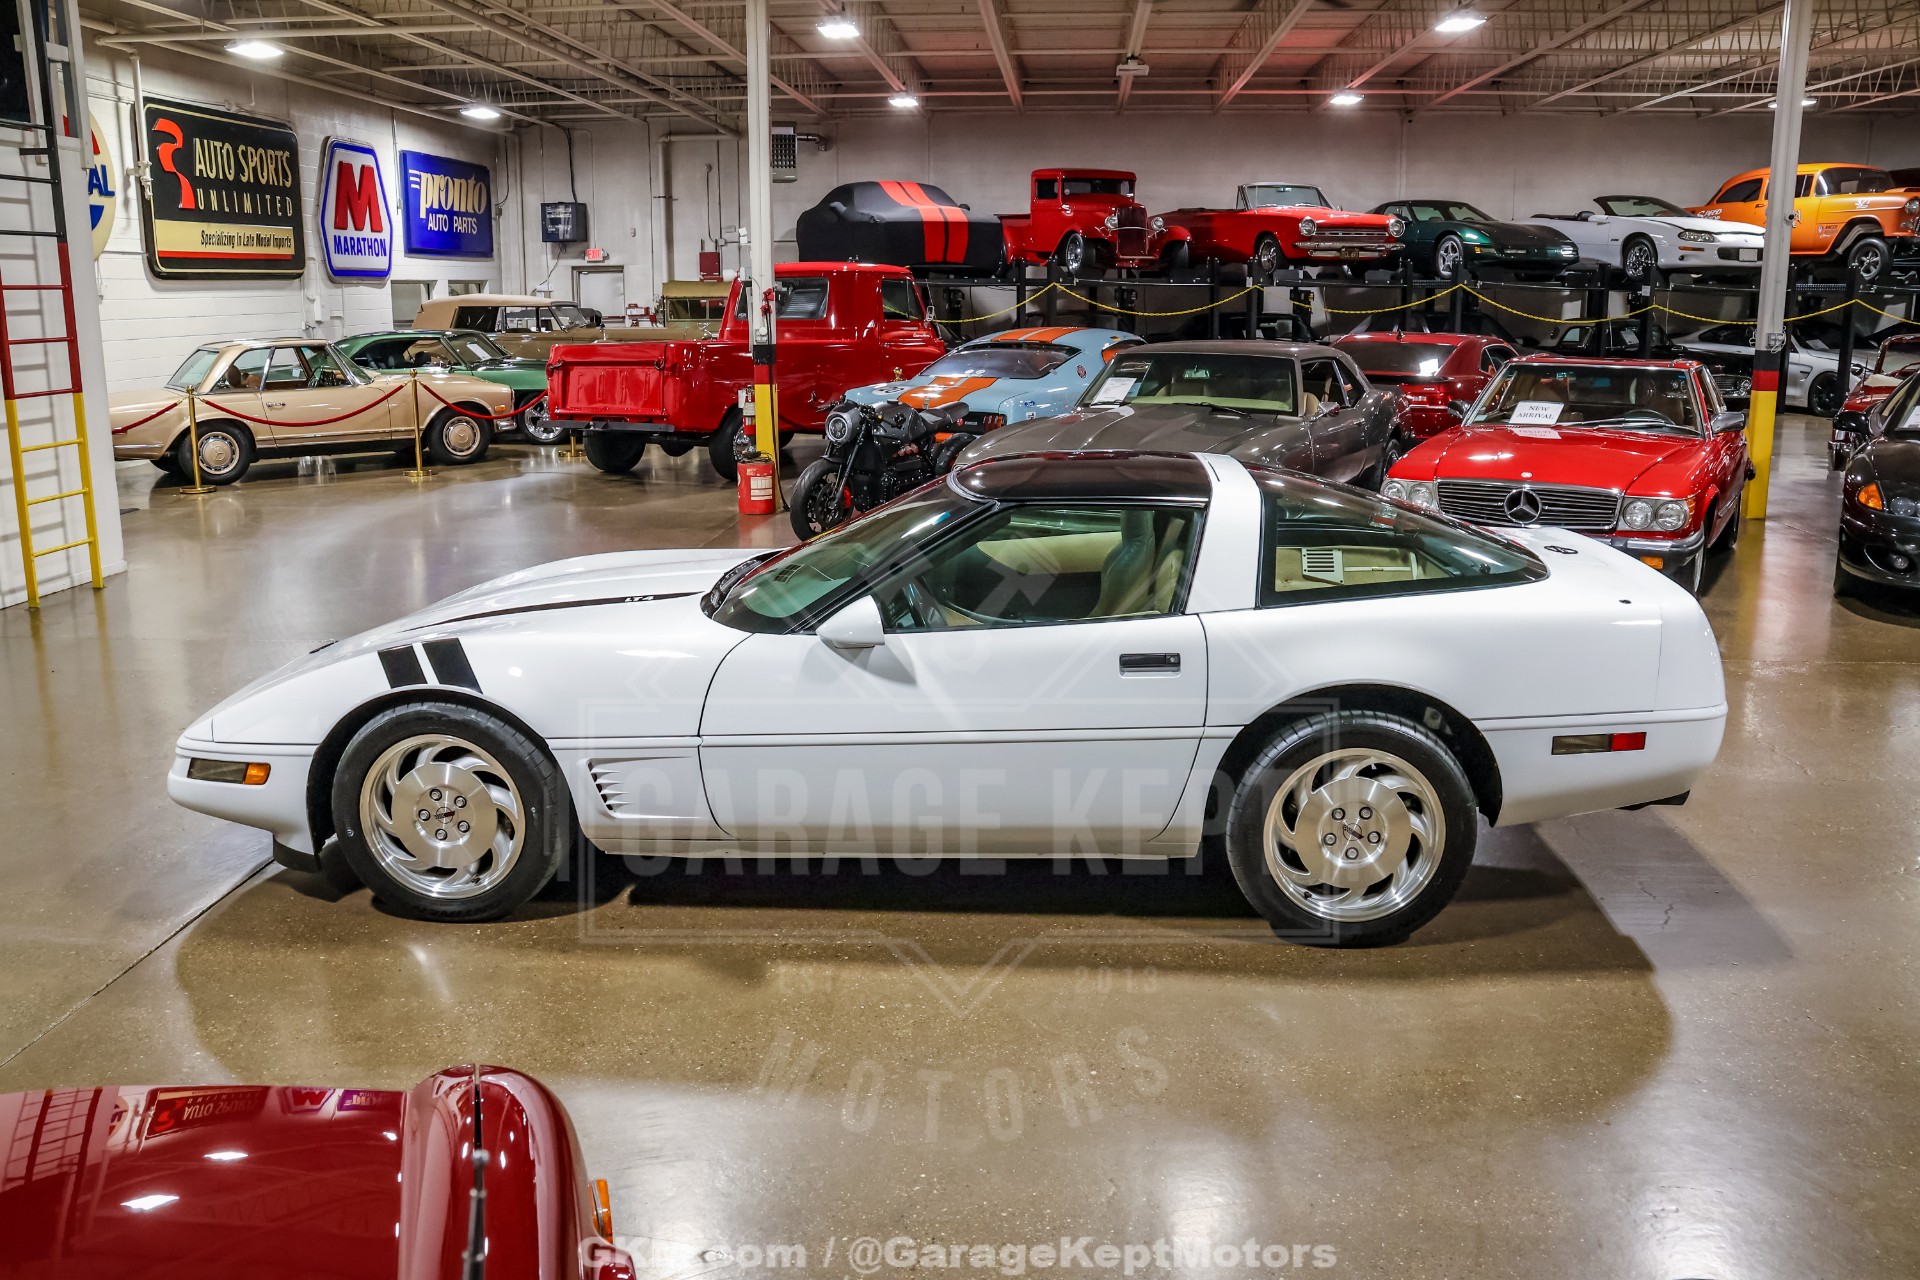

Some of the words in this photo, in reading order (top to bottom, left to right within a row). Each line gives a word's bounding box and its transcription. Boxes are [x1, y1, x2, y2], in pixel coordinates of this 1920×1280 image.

[193, 138, 236, 182] AUTO
[237, 144, 293, 188] SPORTS
[88, 164, 115, 197] AL
[419, 171, 488, 219] pronto
[196, 188, 293, 217] UNLIMITED
[334, 161, 383, 232] M
[428, 213, 449, 232] AUTO
[453, 216, 478, 235] PARTS
[200, 230, 236, 248] Specializing
[236, 234, 242, 247] In
[242, 233, 255, 247] Late
[255, 233, 272, 248] Model
[272, 234, 292, 249] Imports
[333, 235, 387, 257] MARATHON
[587, 249, 602, 260] EXIT
